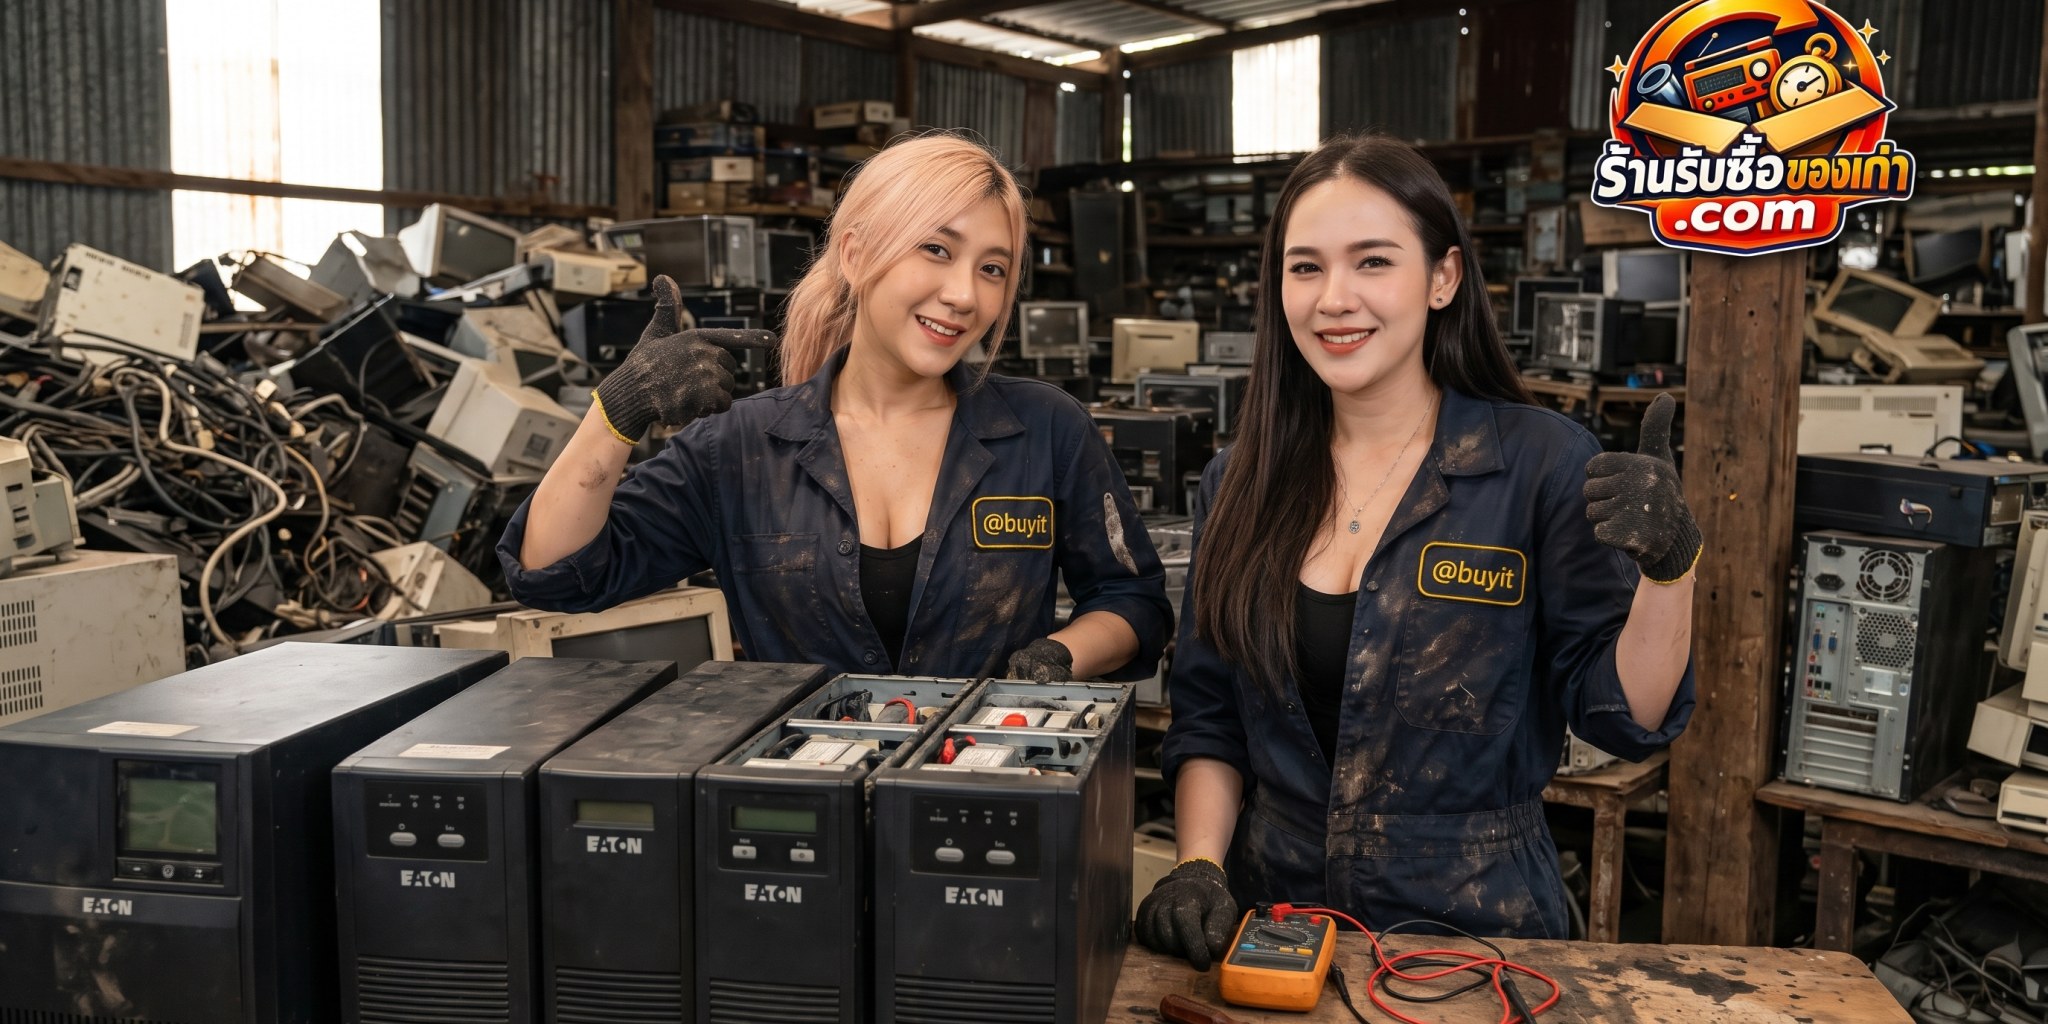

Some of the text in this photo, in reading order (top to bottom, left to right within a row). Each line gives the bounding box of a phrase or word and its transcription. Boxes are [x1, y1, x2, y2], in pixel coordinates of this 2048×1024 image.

[982, 512, 1047, 538] @buyit
[1431, 560, 1515, 590] @buyit
[586, 835, 642, 854] EATON
[400, 869, 456, 888] EATON
[744, 883, 802, 903] EATON
[945, 886, 1003, 906] EATON
[82, 896, 133, 915] EATON
